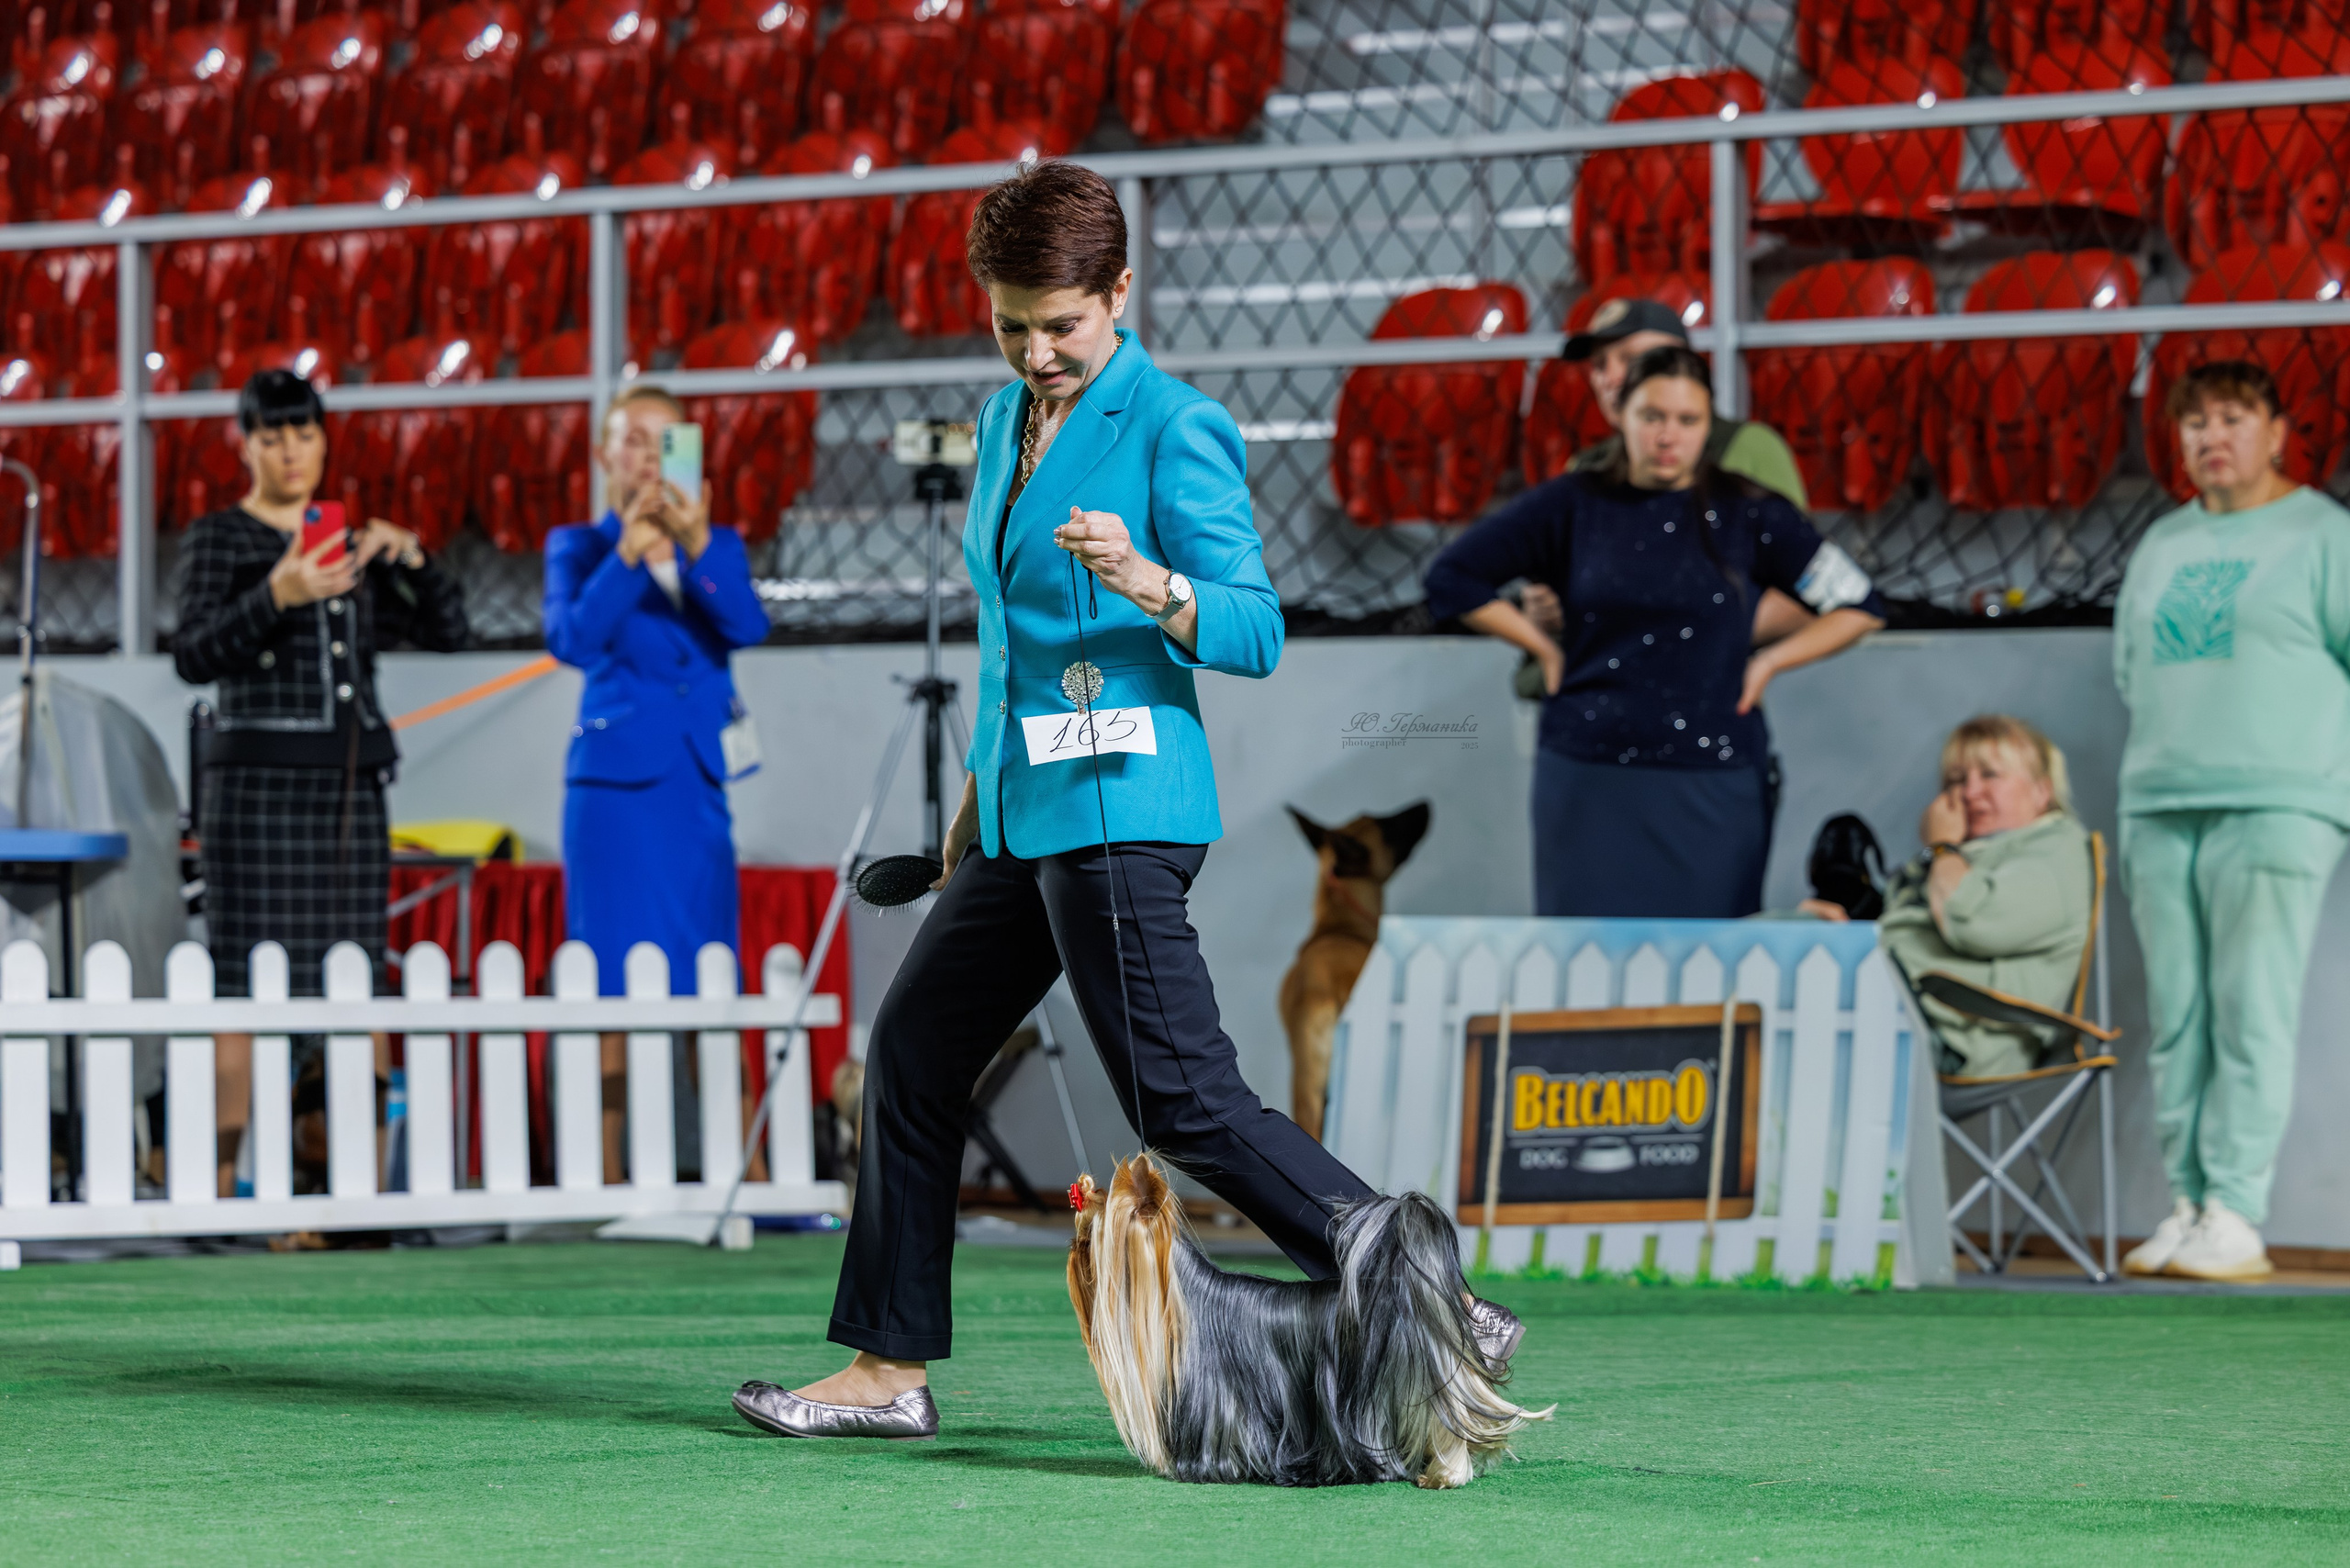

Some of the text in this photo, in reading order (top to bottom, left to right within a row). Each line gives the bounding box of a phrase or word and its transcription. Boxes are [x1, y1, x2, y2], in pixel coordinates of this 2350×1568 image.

[1049, 707, 1137, 753] 165
[1512, 1065, 1707, 1132] BELCANDO
[1519, 1143, 1700, 1170] DOG FOOD
